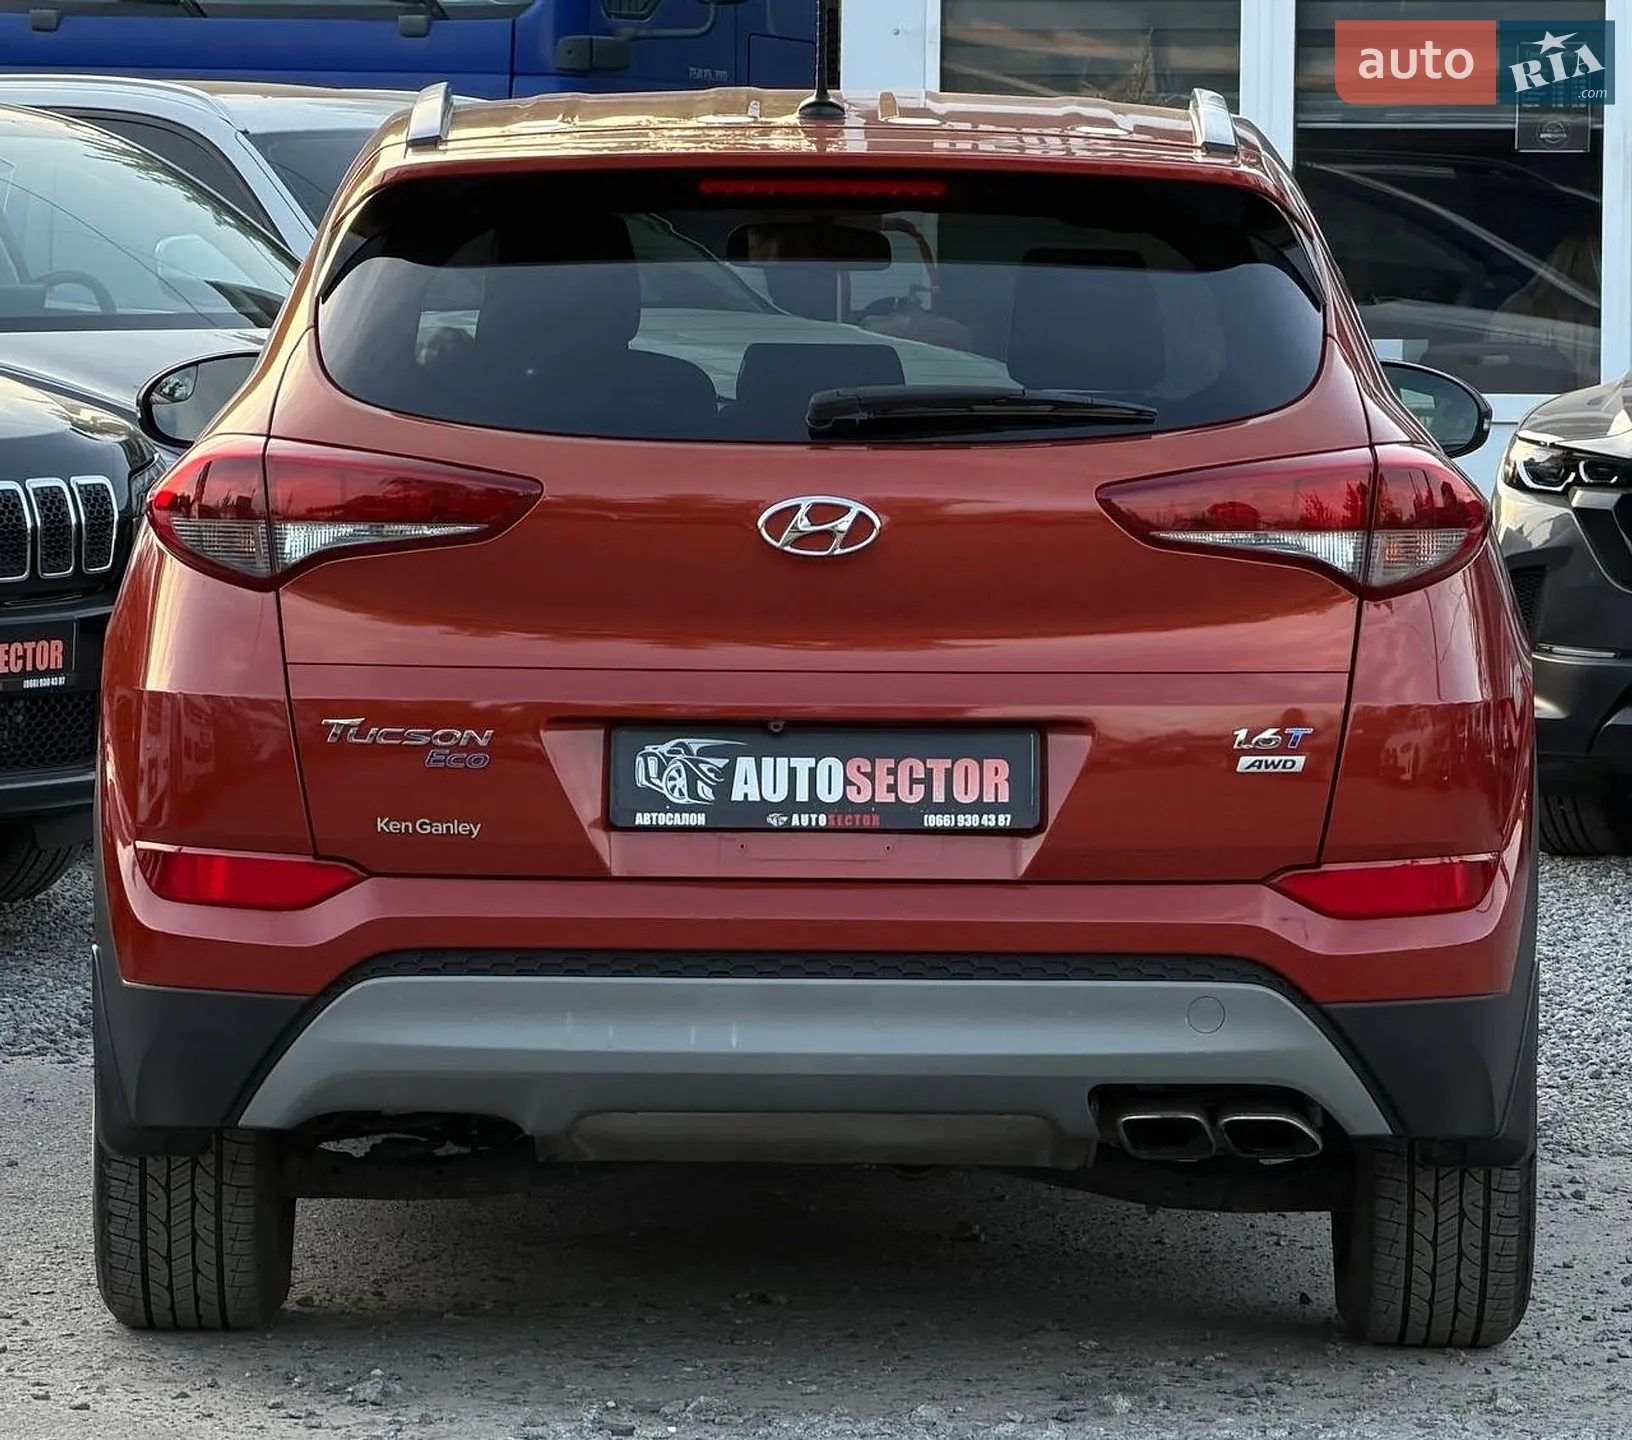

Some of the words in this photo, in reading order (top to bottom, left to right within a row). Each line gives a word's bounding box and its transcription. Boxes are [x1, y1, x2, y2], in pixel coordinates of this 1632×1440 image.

[321, 717, 495, 747] TUCSON
[1242, 758, 1297, 771] AWD
[730, 756, 1011, 804] AUTOSECTOR
[376, 817, 412, 833] Ken
[415, 818, 482, 839] Ganley
[634, 812, 706, 826] АВТОСАЛОН
[923, 814, 955, 827] (066)
[957, 814, 980, 827] 930
[980, 814, 996, 827] 43
[997, 814, 1012, 827] 87
